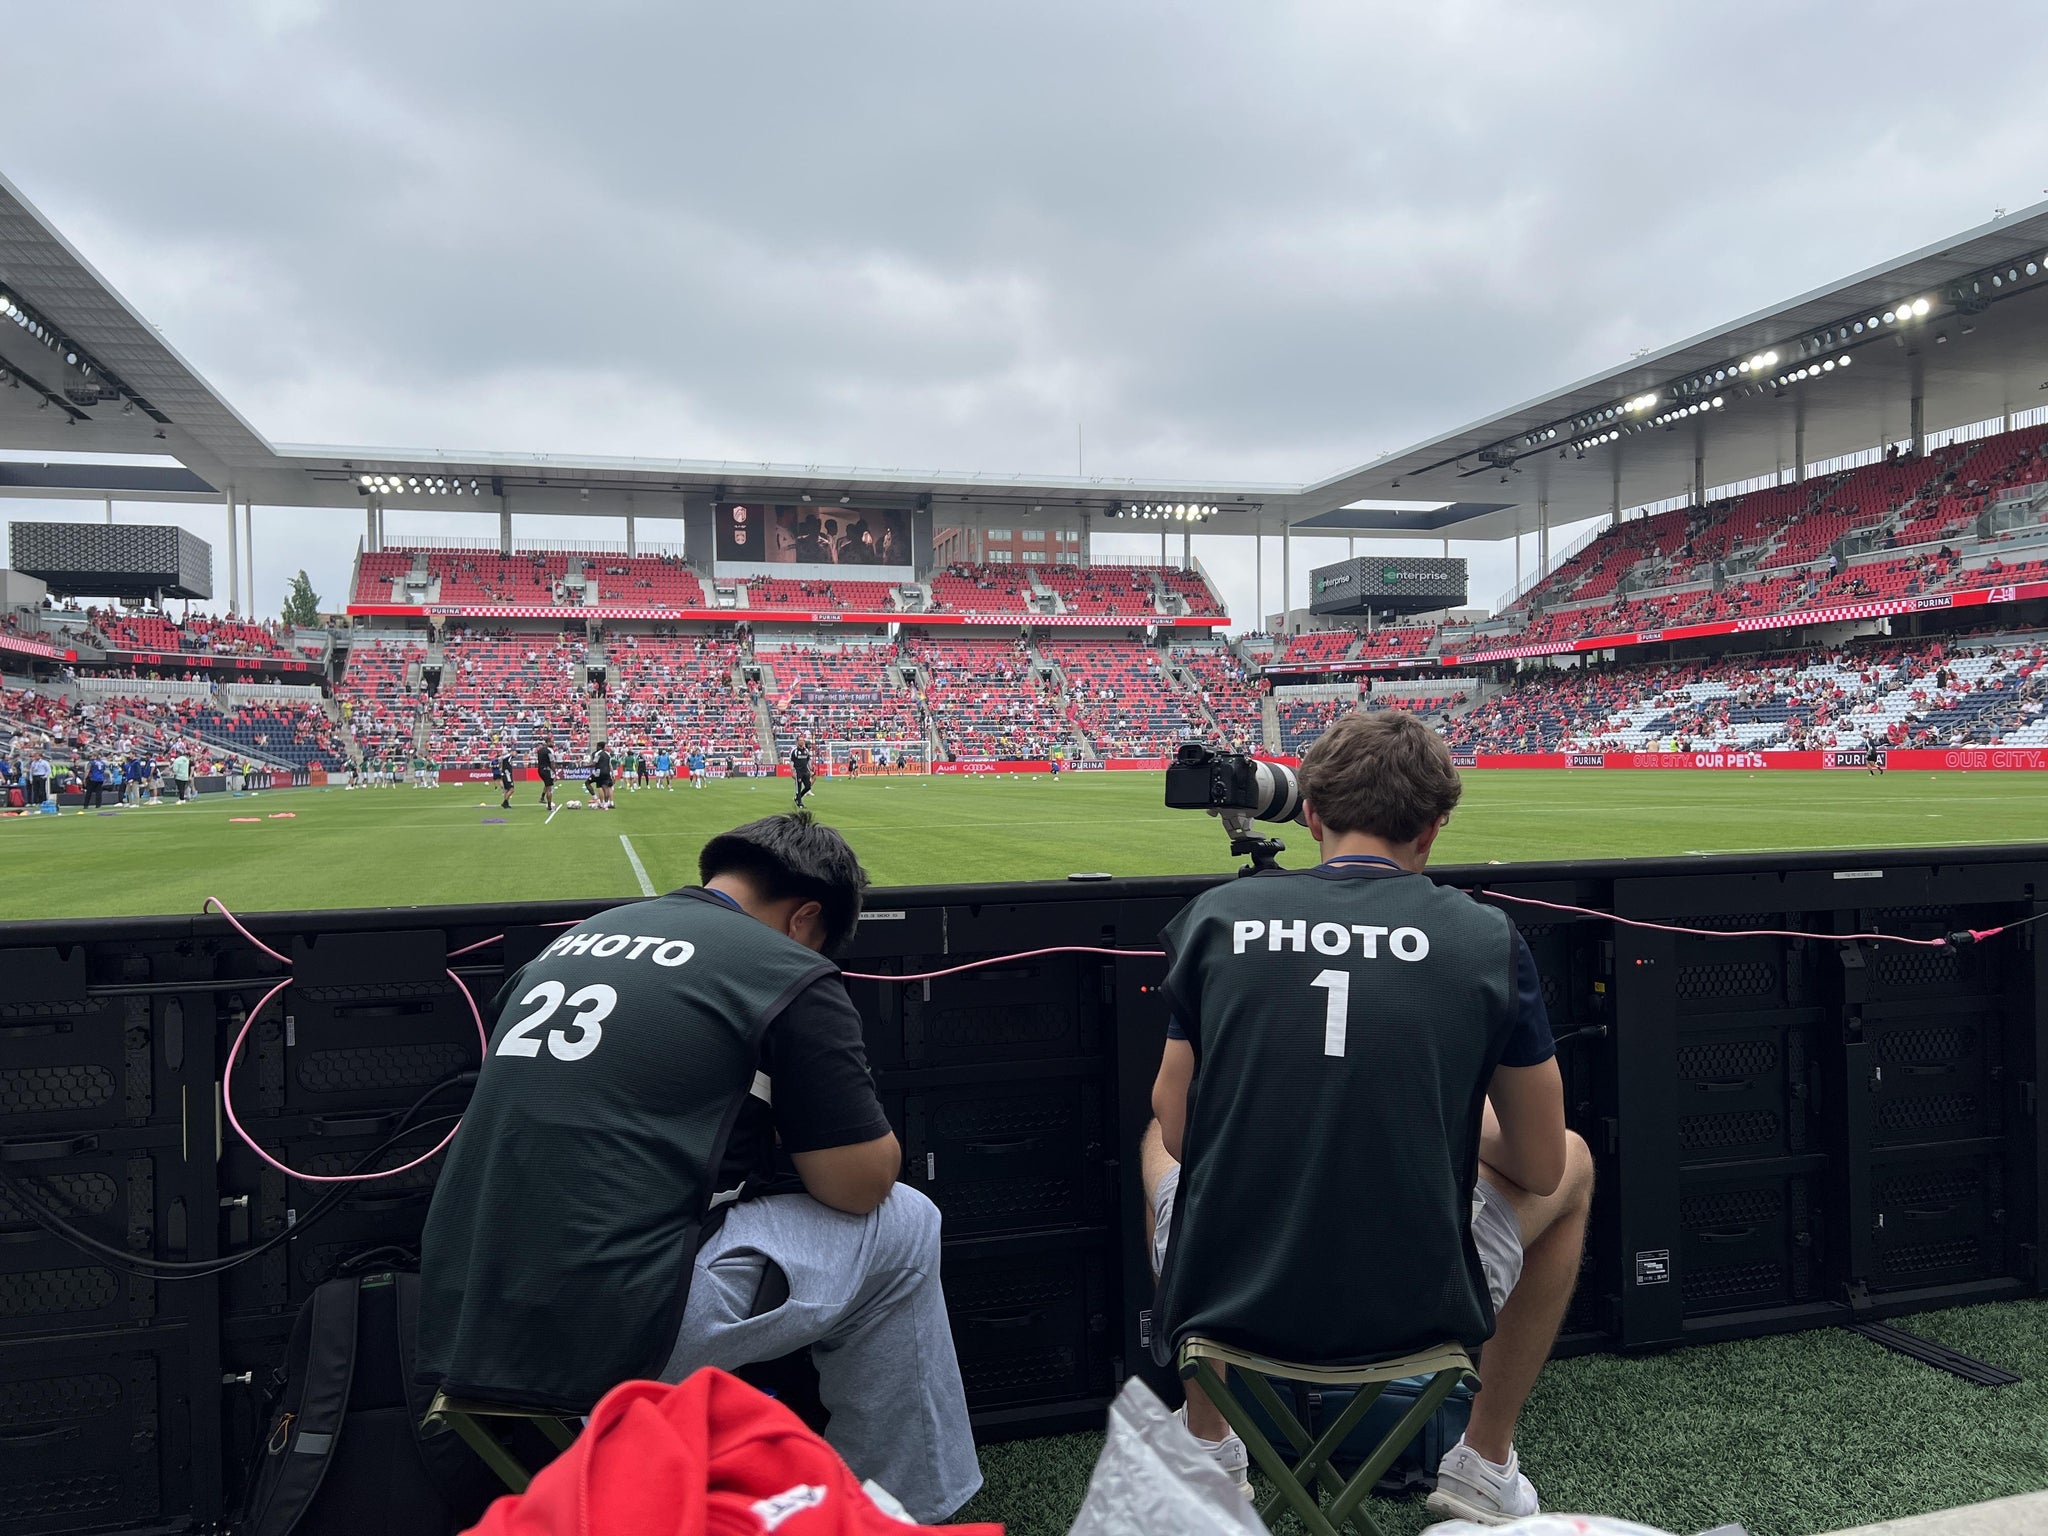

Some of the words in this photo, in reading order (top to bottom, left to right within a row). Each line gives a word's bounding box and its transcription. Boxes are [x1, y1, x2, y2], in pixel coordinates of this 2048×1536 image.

[1384, 570, 1448, 581] enterprise
[1917, 597, 1951, 608] PURINA
[431, 607, 460, 615] PURINA
[1453, 756, 1475, 766] PURINA
[1573, 755, 1603, 765] PURINA
[1633, 754, 1658, 768] OUR
[1661, 754, 1693, 768] CITY.
[1695, 754, 1723, 768] OUR
[1727, 753, 1767, 768] PETS.
[1837, 754, 1884, 765] PURIA
[1945, 751, 1986, 767] OUR
[1992, 751, 2045, 767] CITY.
[1233, 919, 1430, 962] PHOTO
[539, 933, 695, 967] PHOTO
[1309, 968, 1350, 1058] 1
[495, 980, 618, 1062] 23
